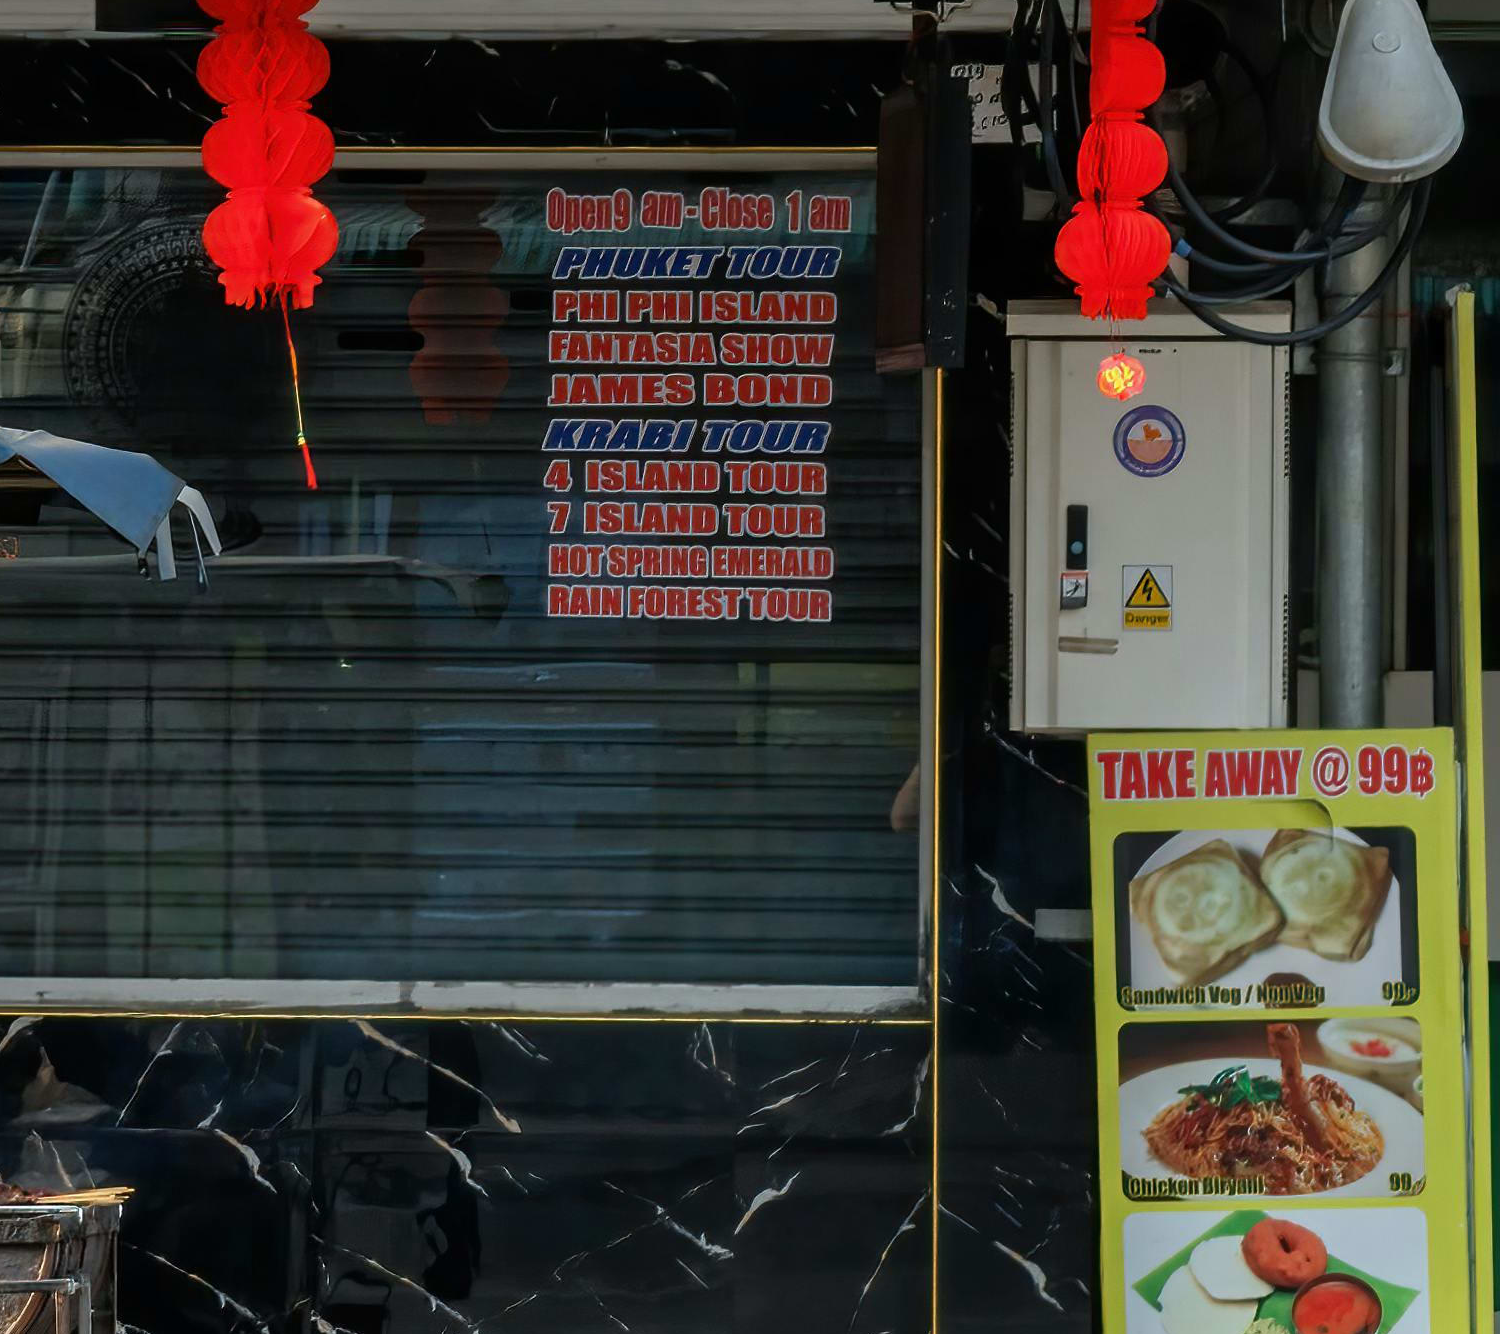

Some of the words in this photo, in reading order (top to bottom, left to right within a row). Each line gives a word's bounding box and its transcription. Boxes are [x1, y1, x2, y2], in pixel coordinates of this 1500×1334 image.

[785, 190, 802, 233] 1
[810, 196, 852, 233] am
[552, 246, 725, 279] PHUKET
[726, 246, 841, 278] TOUR
[553, 291, 619, 322] PHI
[626, 291, 693, 323] PHI
[699, 291, 837, 323] ISLAND
[549, 332, 717, 364] FANTASIA
[720, 333, 834, 365] SHOW
[547, 374, 695, 406] JAMES
[704, 374, 833, 406] BOND
[542, 419, 697, 451] KRABI
[702, 420, 832, 453] TOUR
[543, 460, 572, 492] 4
[584, 461, 720, 493] ISLAND
[724, 462, 828, 495] TOUR
[547, 502, 571, 534] 7
[583, 502, 719, 534] ISLAND
[722, 504, 825, 537] TOUR
[549, 545, 606, 576] HOT
[607, 546, 708, 578] SPRING
[711, 546, 834, 579] EMERALD
[548, 585, 622, 617] RAIN
[627, 587, 743, 620] FOREST
[743, 588, 832, 622] TOUR
[1097, 749, 1197, 800] TAKE
[1204, 748, 1303, 798] AWAY
[1312, 745, 1350, 796] @
[1121, 985, 1206, 1005] Sandwich
[1129, 1175, 1200, 1196] Chicken
